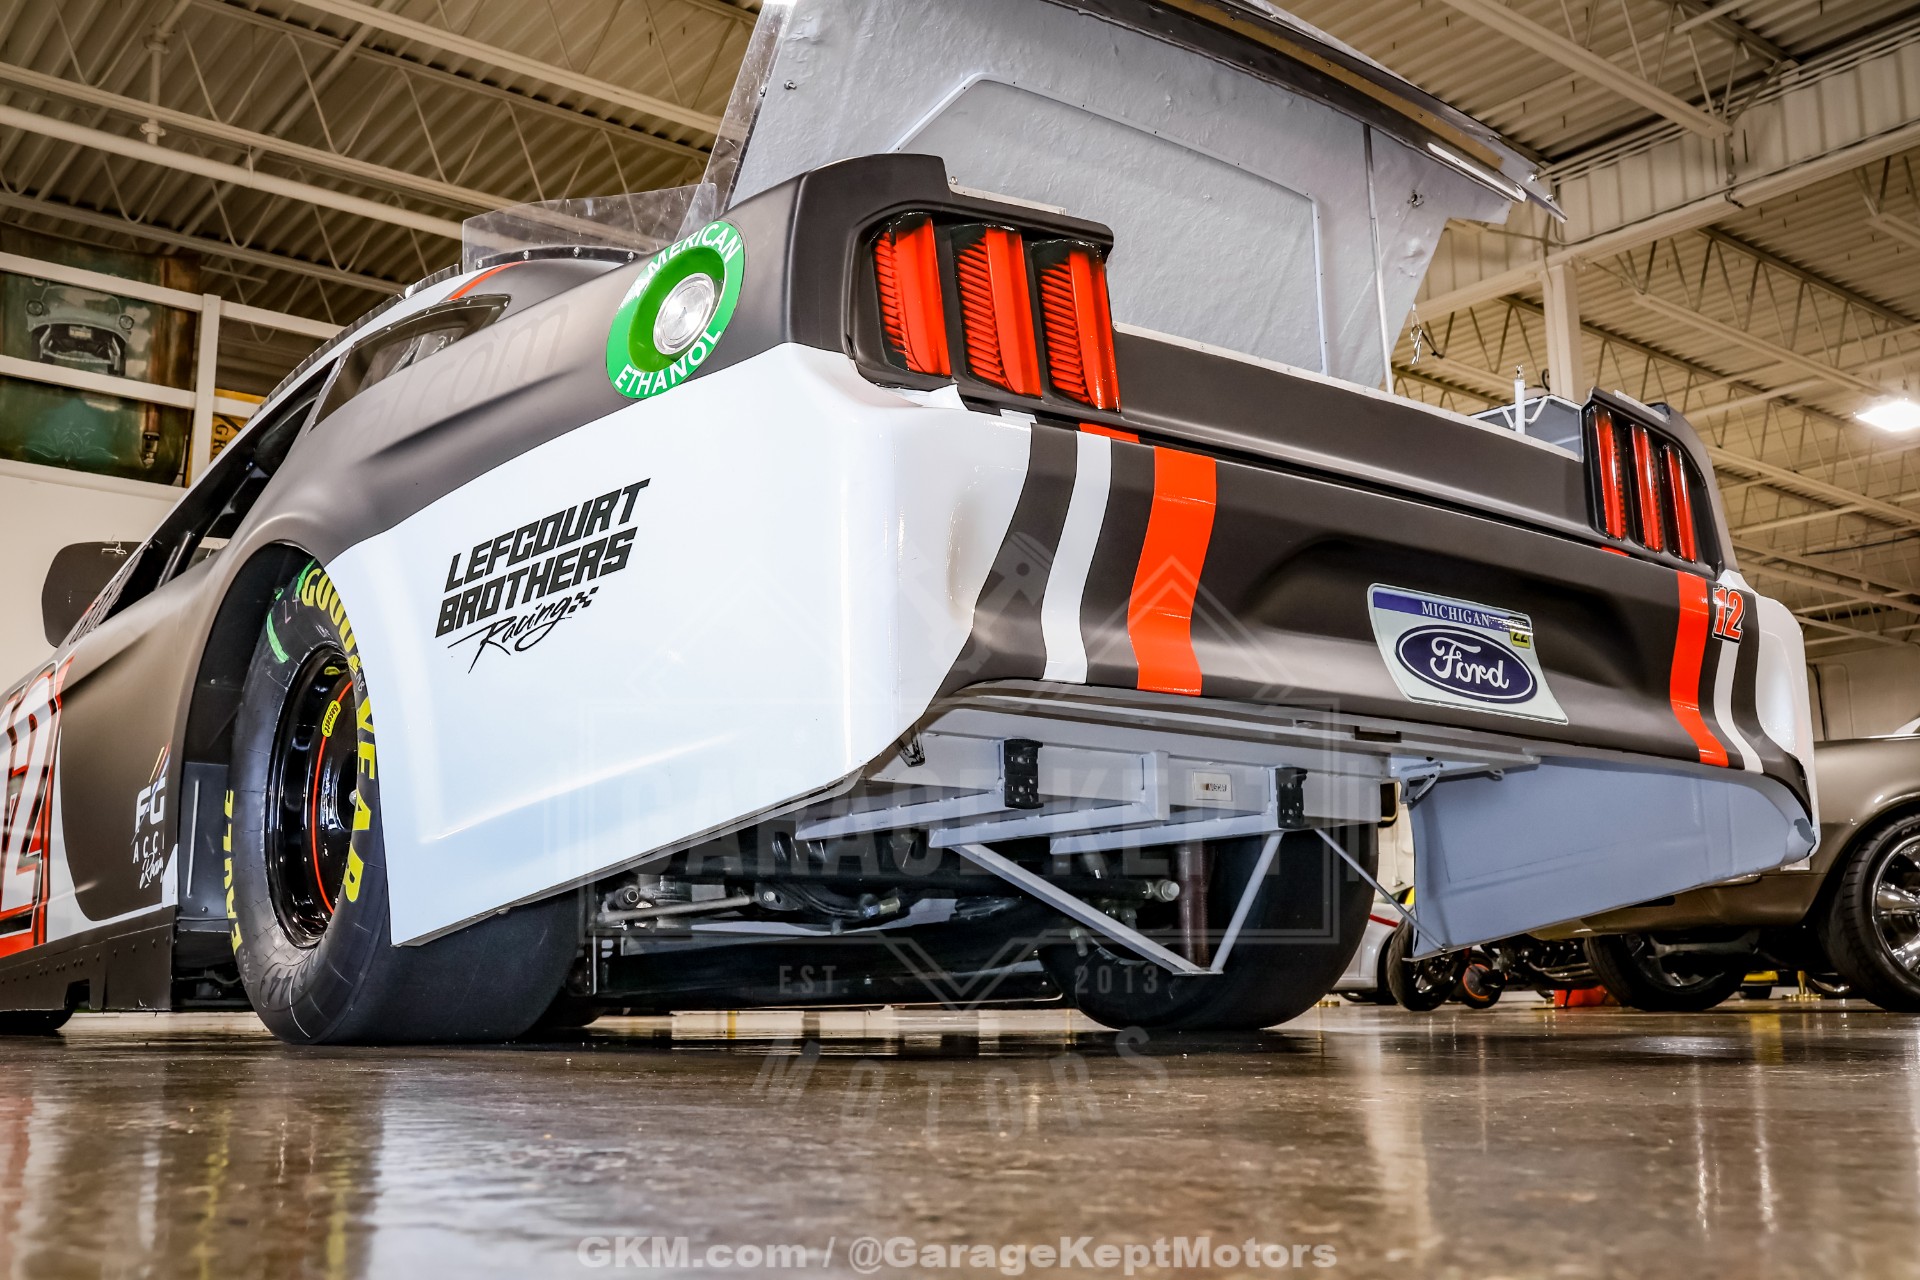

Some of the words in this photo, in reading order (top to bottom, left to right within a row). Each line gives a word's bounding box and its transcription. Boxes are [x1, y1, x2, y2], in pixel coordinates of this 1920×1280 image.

[629, 222, 743, 298] AMERICAN
[614, 329, 722, 395] ETHANOL
[444, 477, 651, 593] LEFCOURT
[434, 526, 638, 638] BROTHERS
[1421, 600, 1490, 628] MICHIGAN
[1712, 585, 1745, 643] 12
[447, 596, 574, 675] Racing
[1429, 635, 1511, 690] Ford
